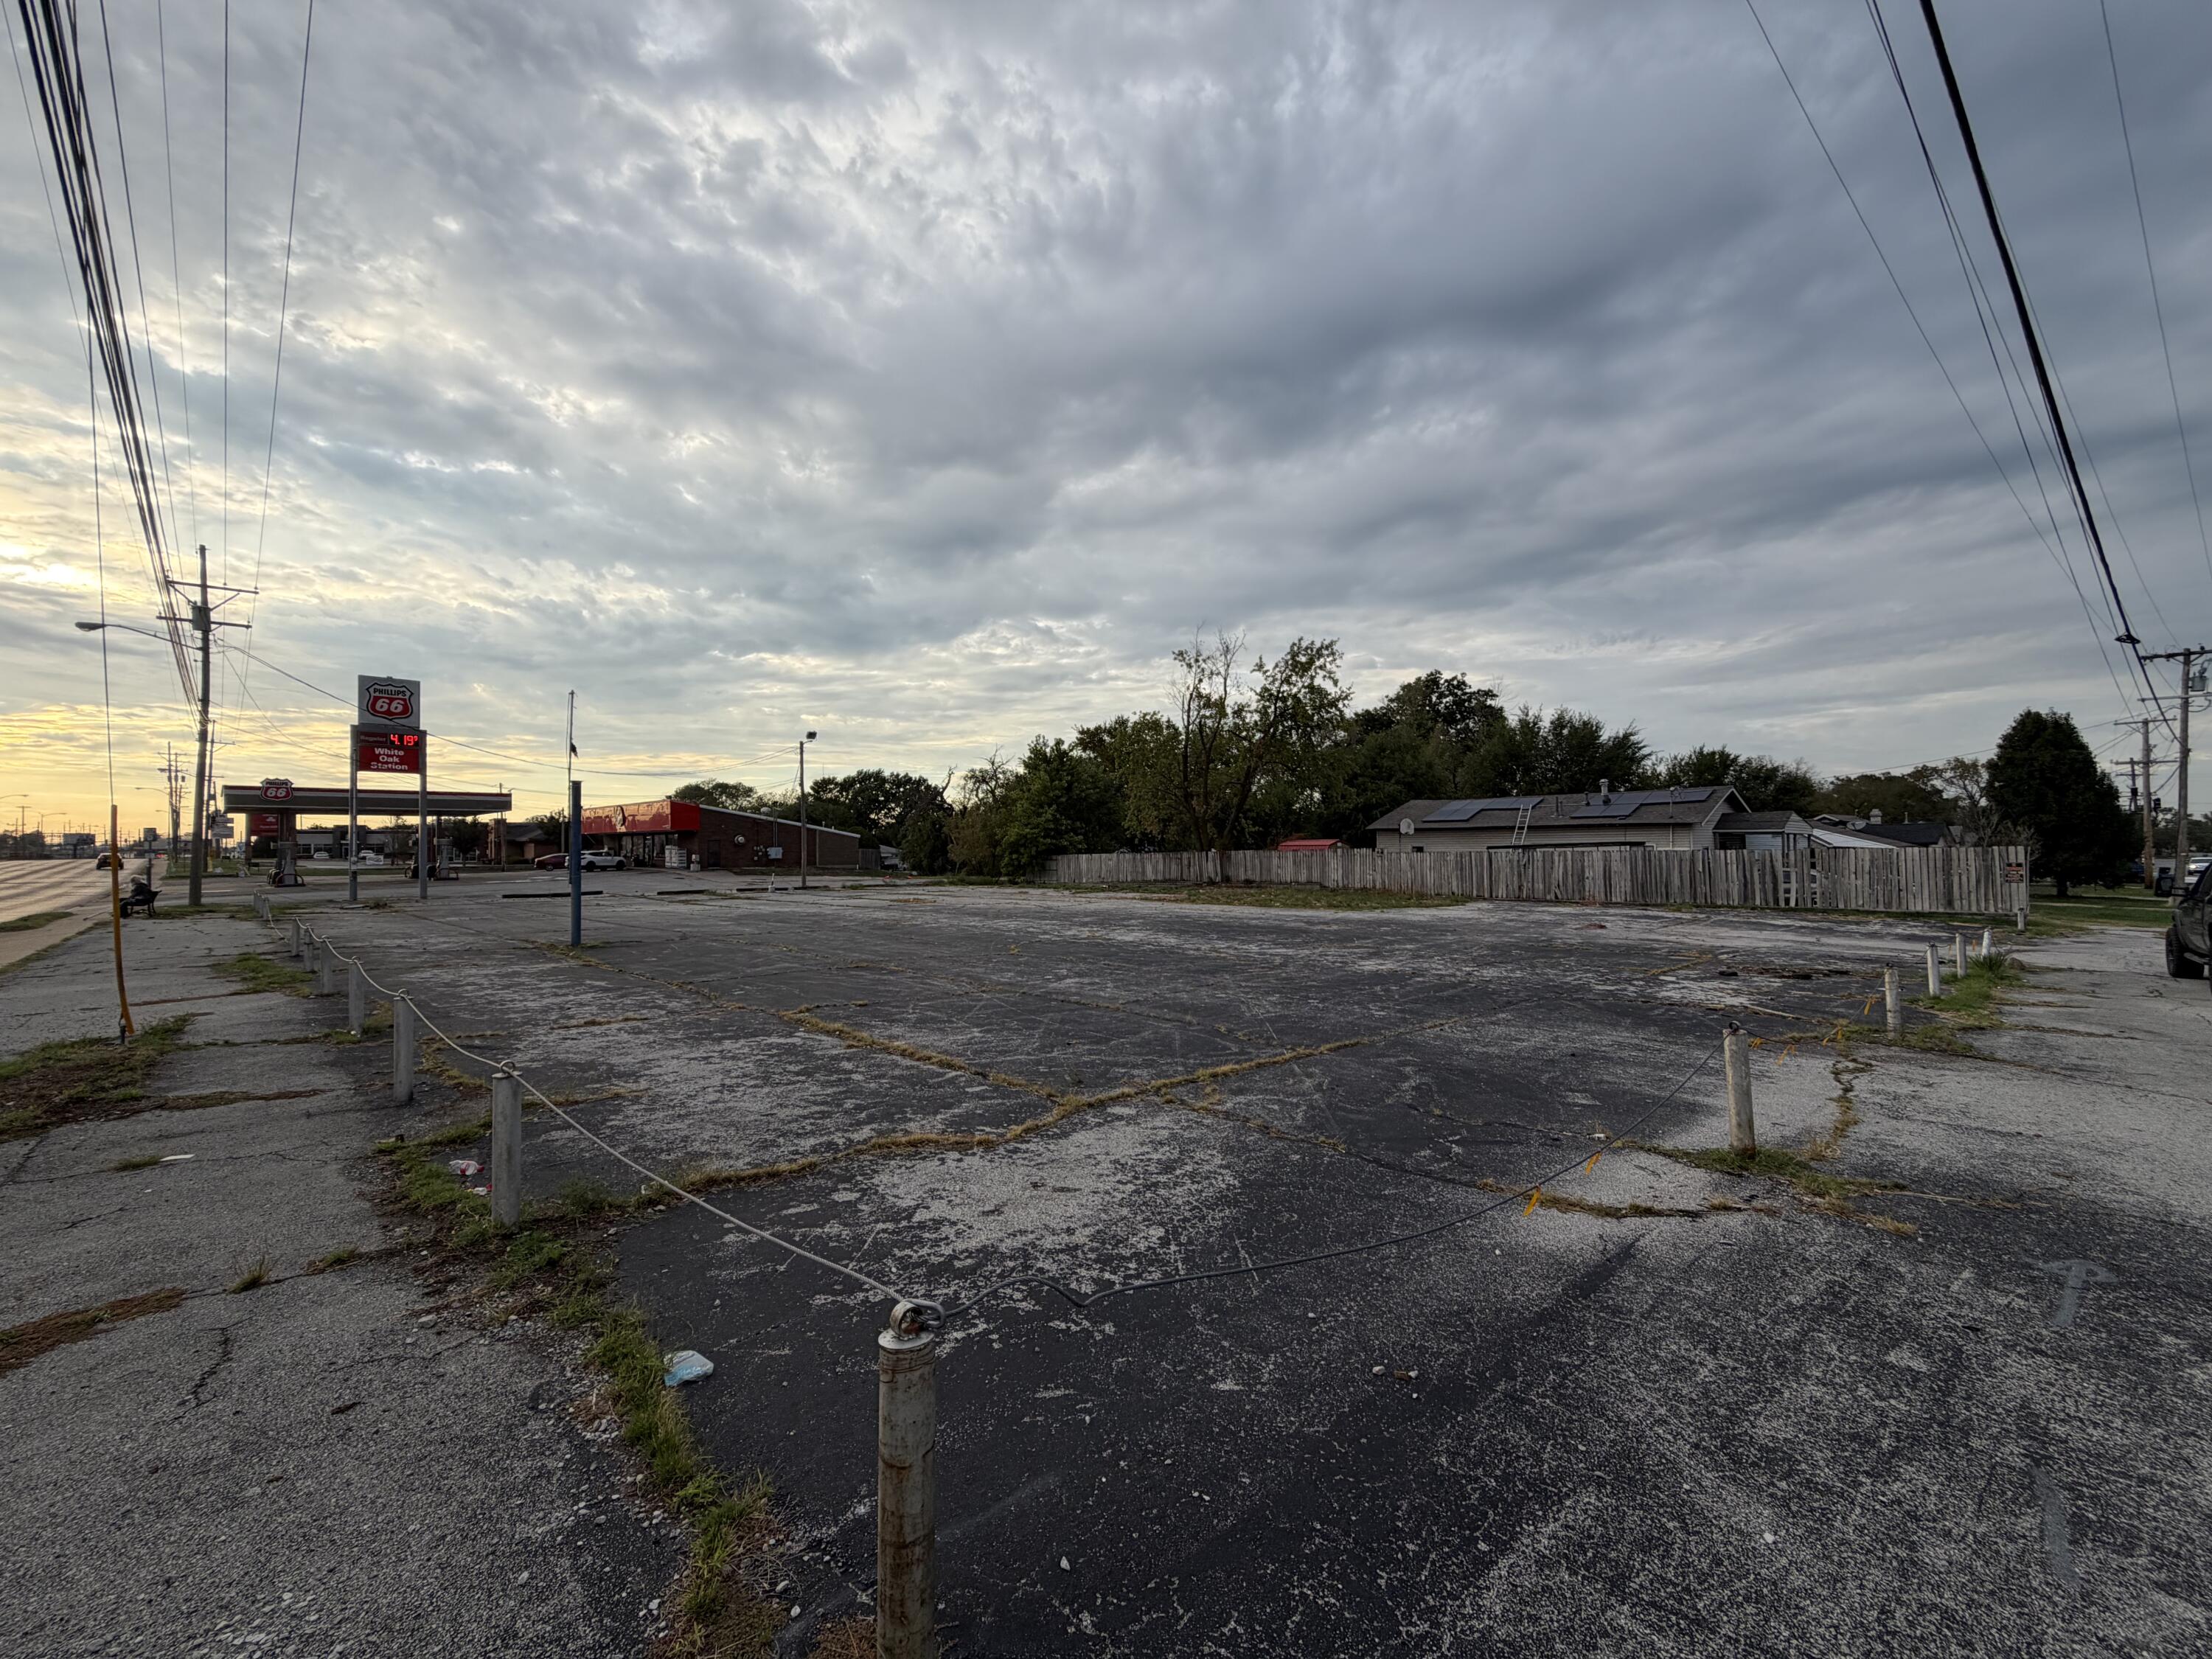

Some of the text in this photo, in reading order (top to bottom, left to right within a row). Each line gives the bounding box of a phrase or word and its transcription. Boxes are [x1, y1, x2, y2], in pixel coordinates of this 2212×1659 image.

[374, 687, 407, 697] PHILLIPS
[375, 698, 405, 713] 66
[375, 747, 405, 756] White
[370, 762, 408, 771] Station
[266, 787, 287, 797] 66
